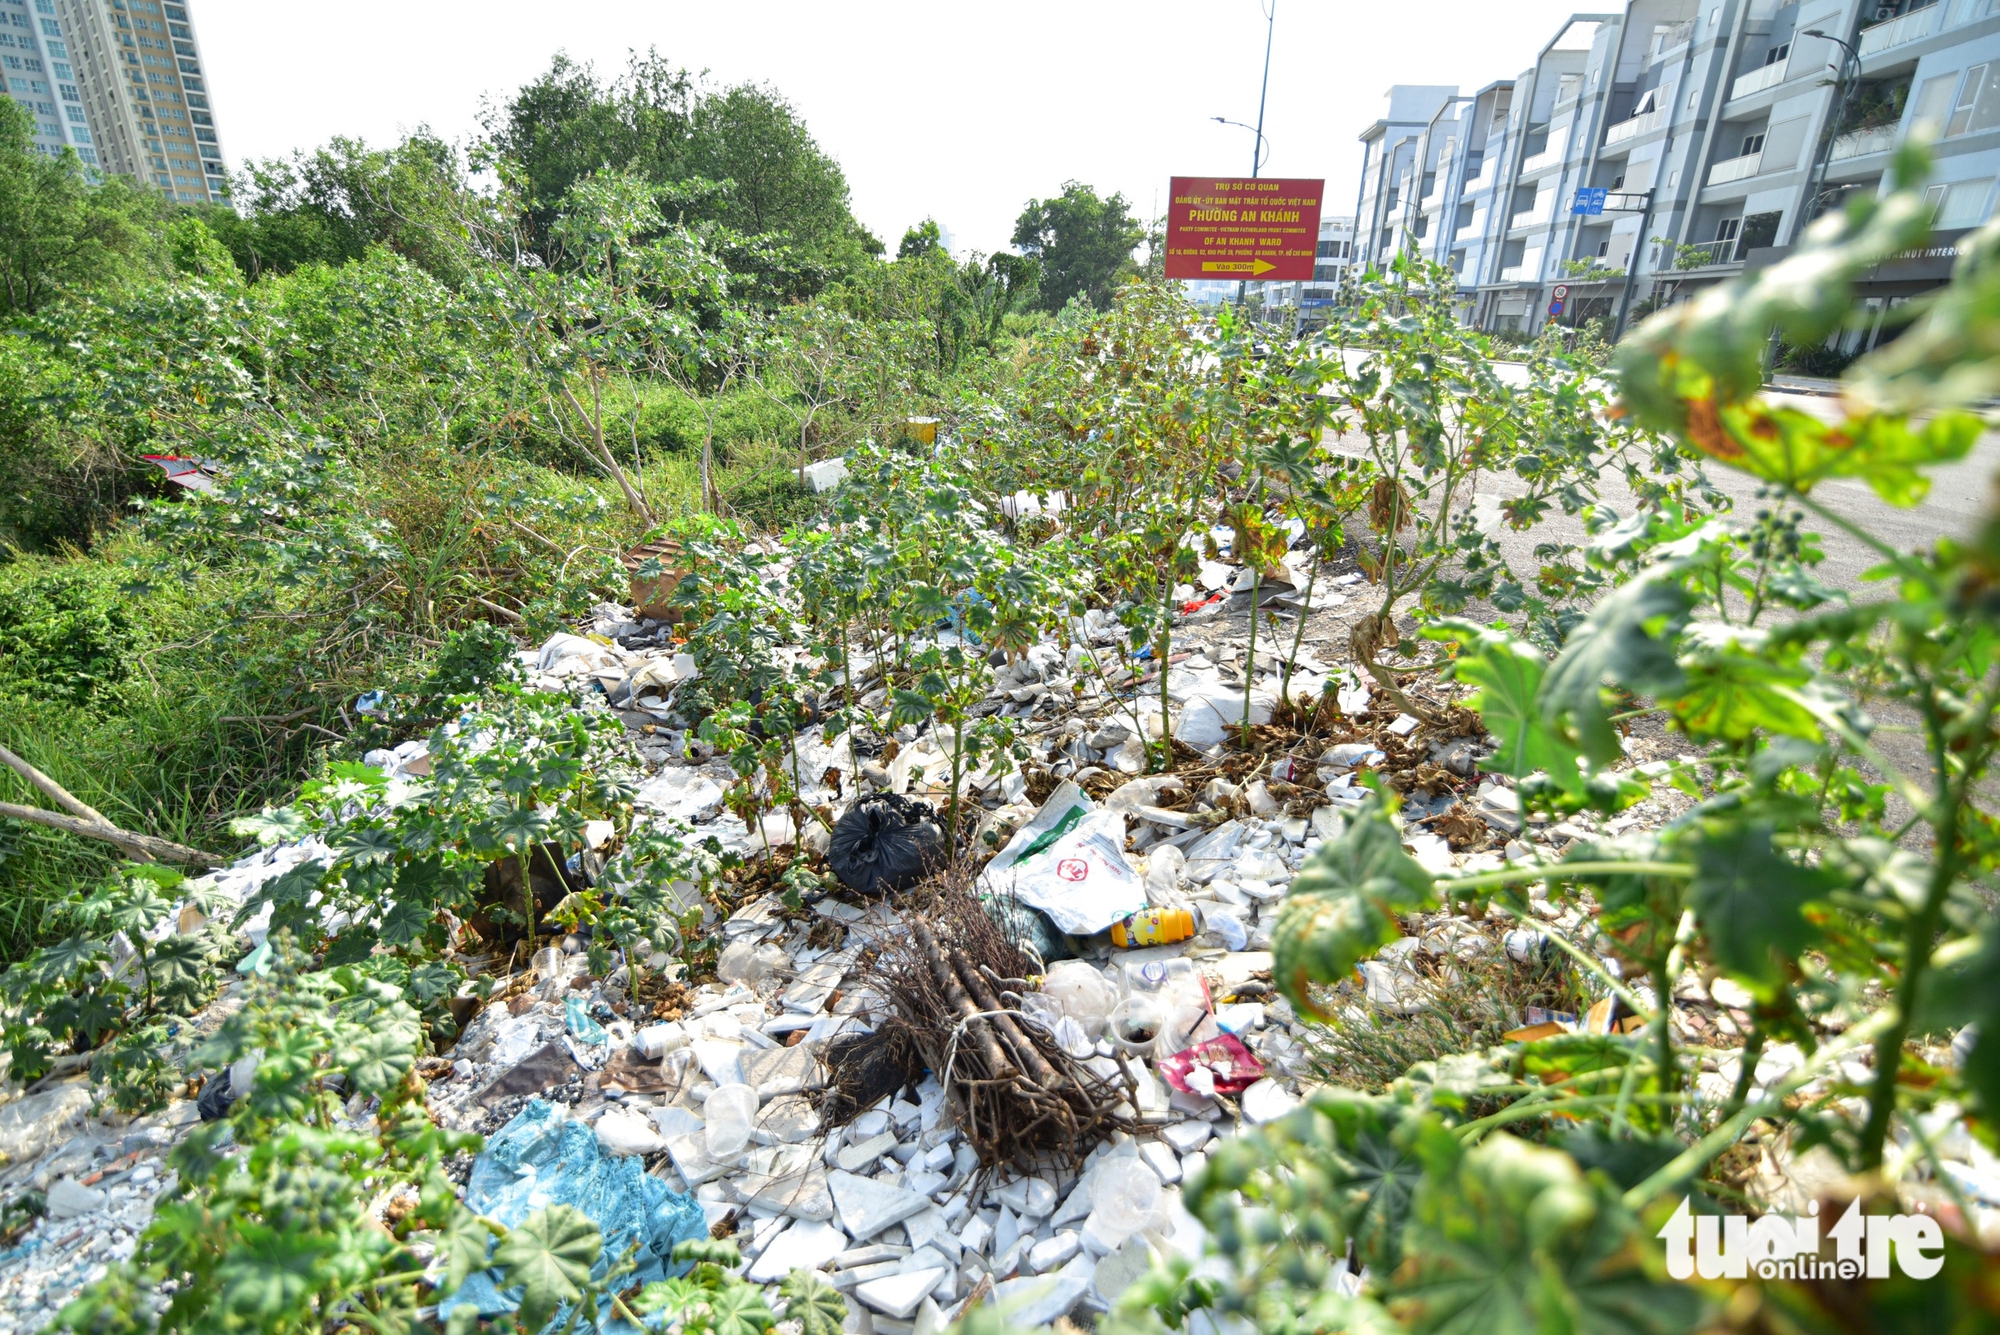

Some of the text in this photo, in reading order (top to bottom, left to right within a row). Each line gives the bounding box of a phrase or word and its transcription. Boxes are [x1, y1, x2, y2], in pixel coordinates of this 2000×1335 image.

[1215, 183, 1230, 191] TRỤ
[1232, 181, 1243, 190] SỞ
[1245, 183, 1256, 191] CƠ
[1215, 197, 1227, 205] BAN
[1229, 196, 1242, 206] MẶT
[1243, 196, 1259, 206] TRẬN
[1270, 196, 1287, 206] QUỐC
[1288, 197, 1301, 207] VIỆT
[1189, 207, 1300, 223] PHƯỜNG AN KHÁNH
[1204, 237, 1282, 246] OF AN KHANH WARD
[1925, 247, 1967, 257] INTERIO
[1556, 288, 1565, 296] 50
